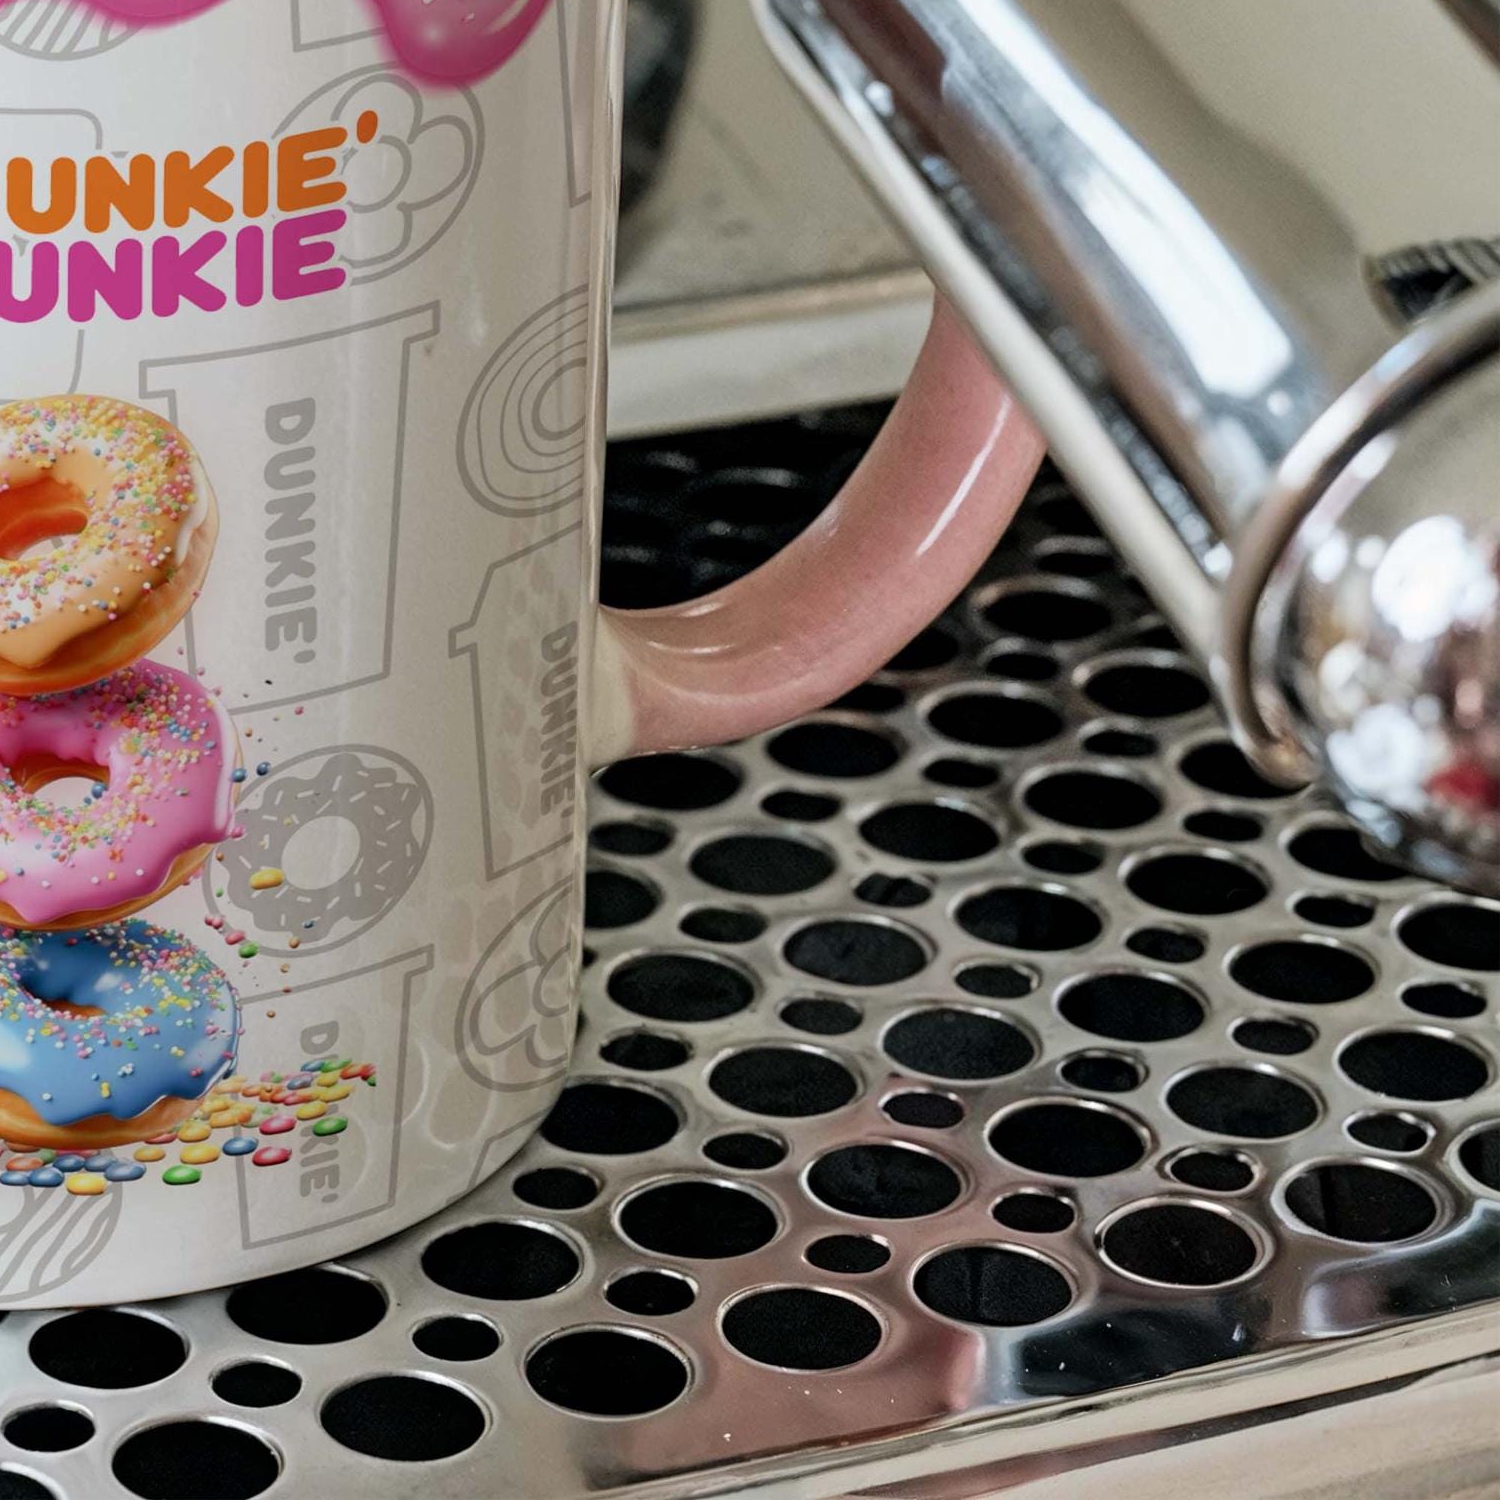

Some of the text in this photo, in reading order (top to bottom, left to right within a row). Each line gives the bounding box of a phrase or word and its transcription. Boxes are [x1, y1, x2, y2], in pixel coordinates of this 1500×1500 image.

[263, 396, 319, 667] DUNKIE'
[540, 620, 578, 819] DUNKIE'
[299, 1020, 340, 1204] DKIE'
